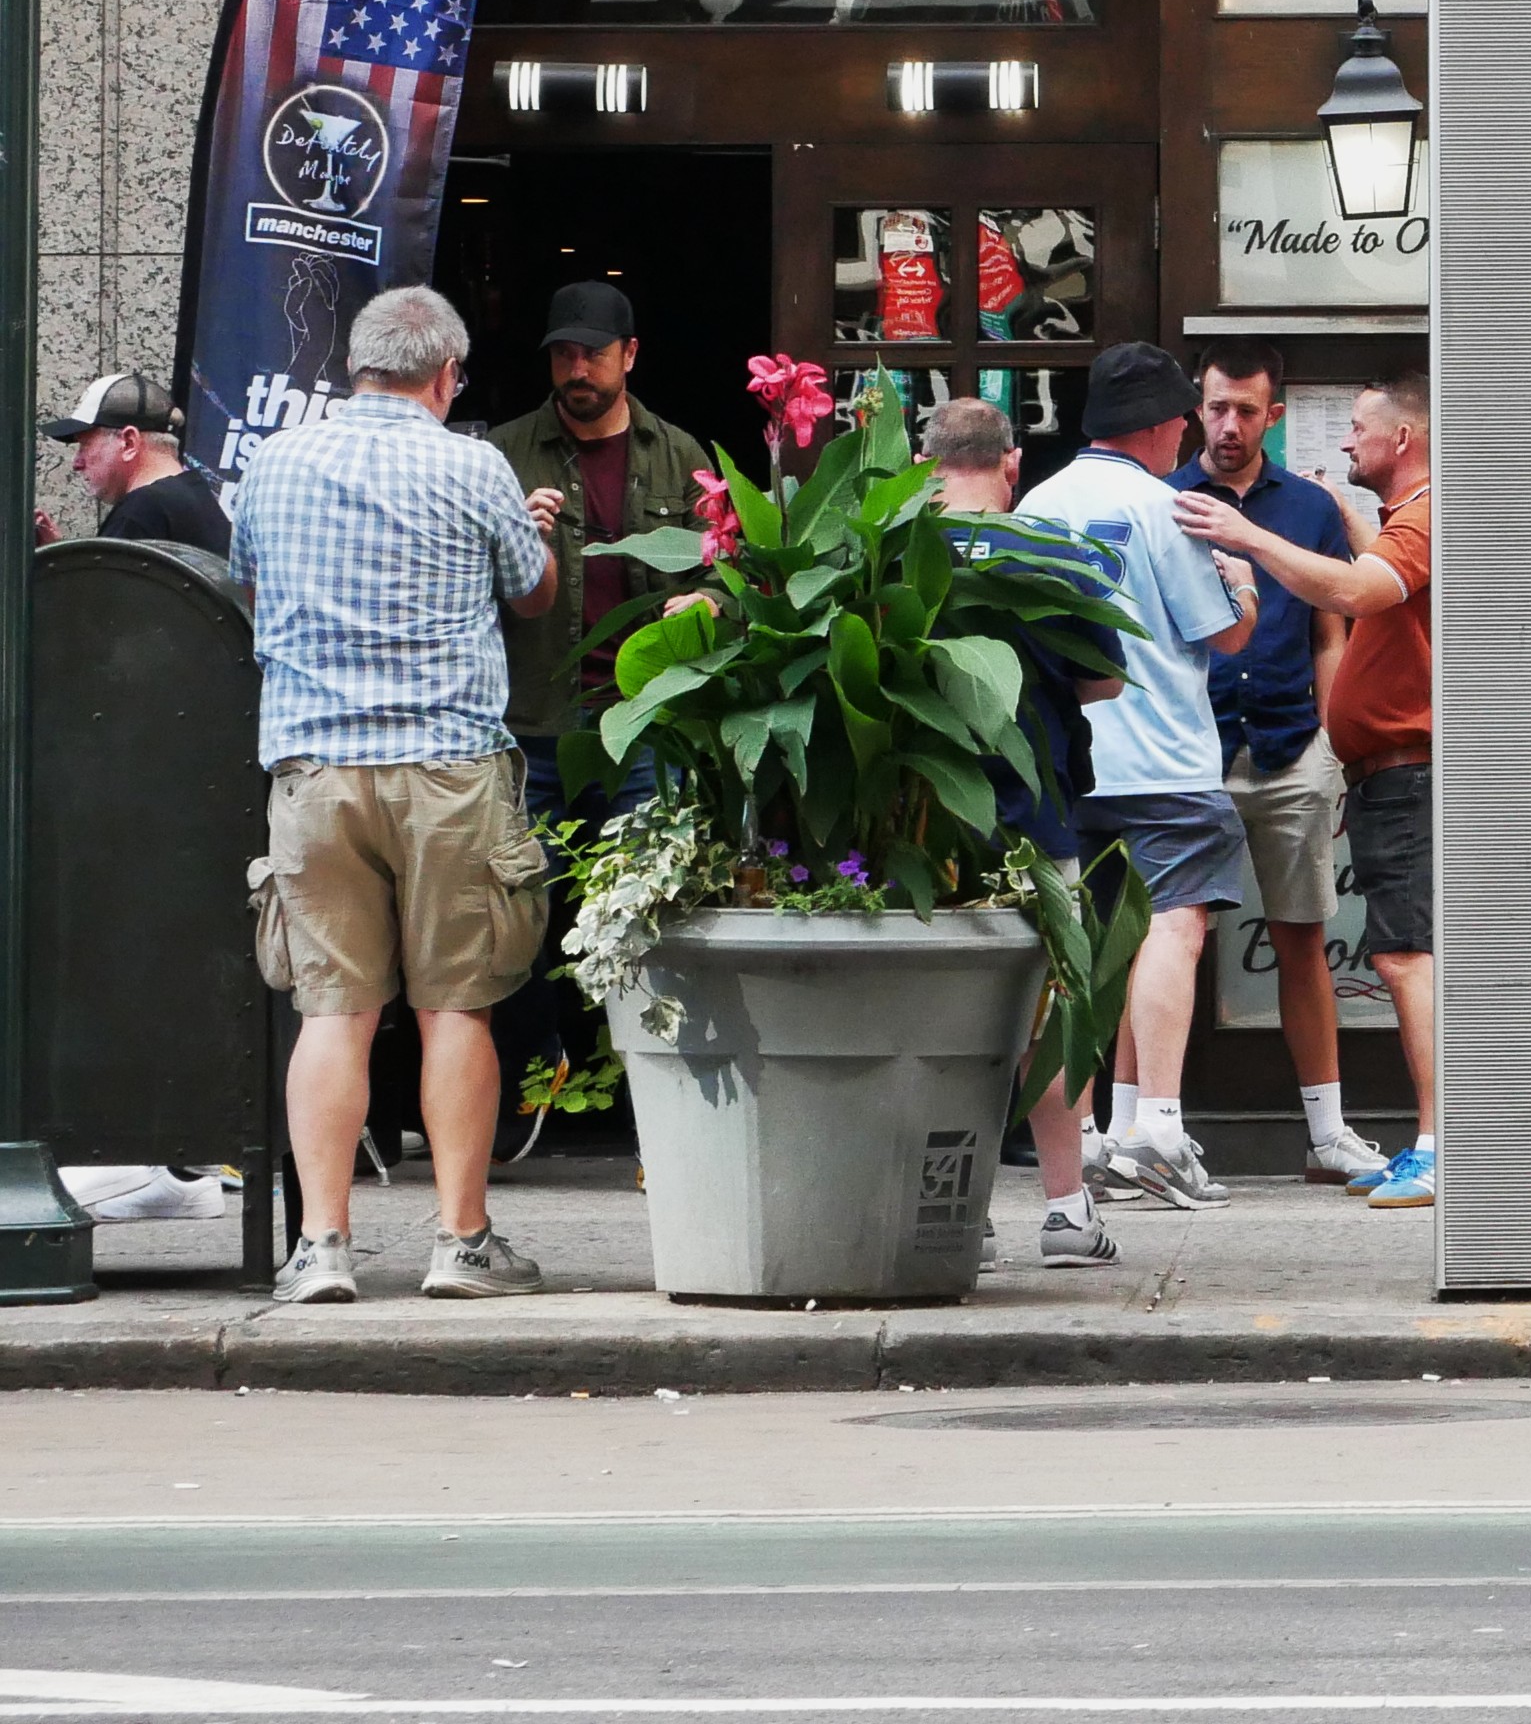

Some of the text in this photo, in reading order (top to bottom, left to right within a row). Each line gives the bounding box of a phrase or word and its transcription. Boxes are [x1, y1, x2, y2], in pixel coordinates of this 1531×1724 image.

[256, 216, 374, 251] manchester
[1351, 224, 1384, 254] to
[219, 419, 264, 471] is
